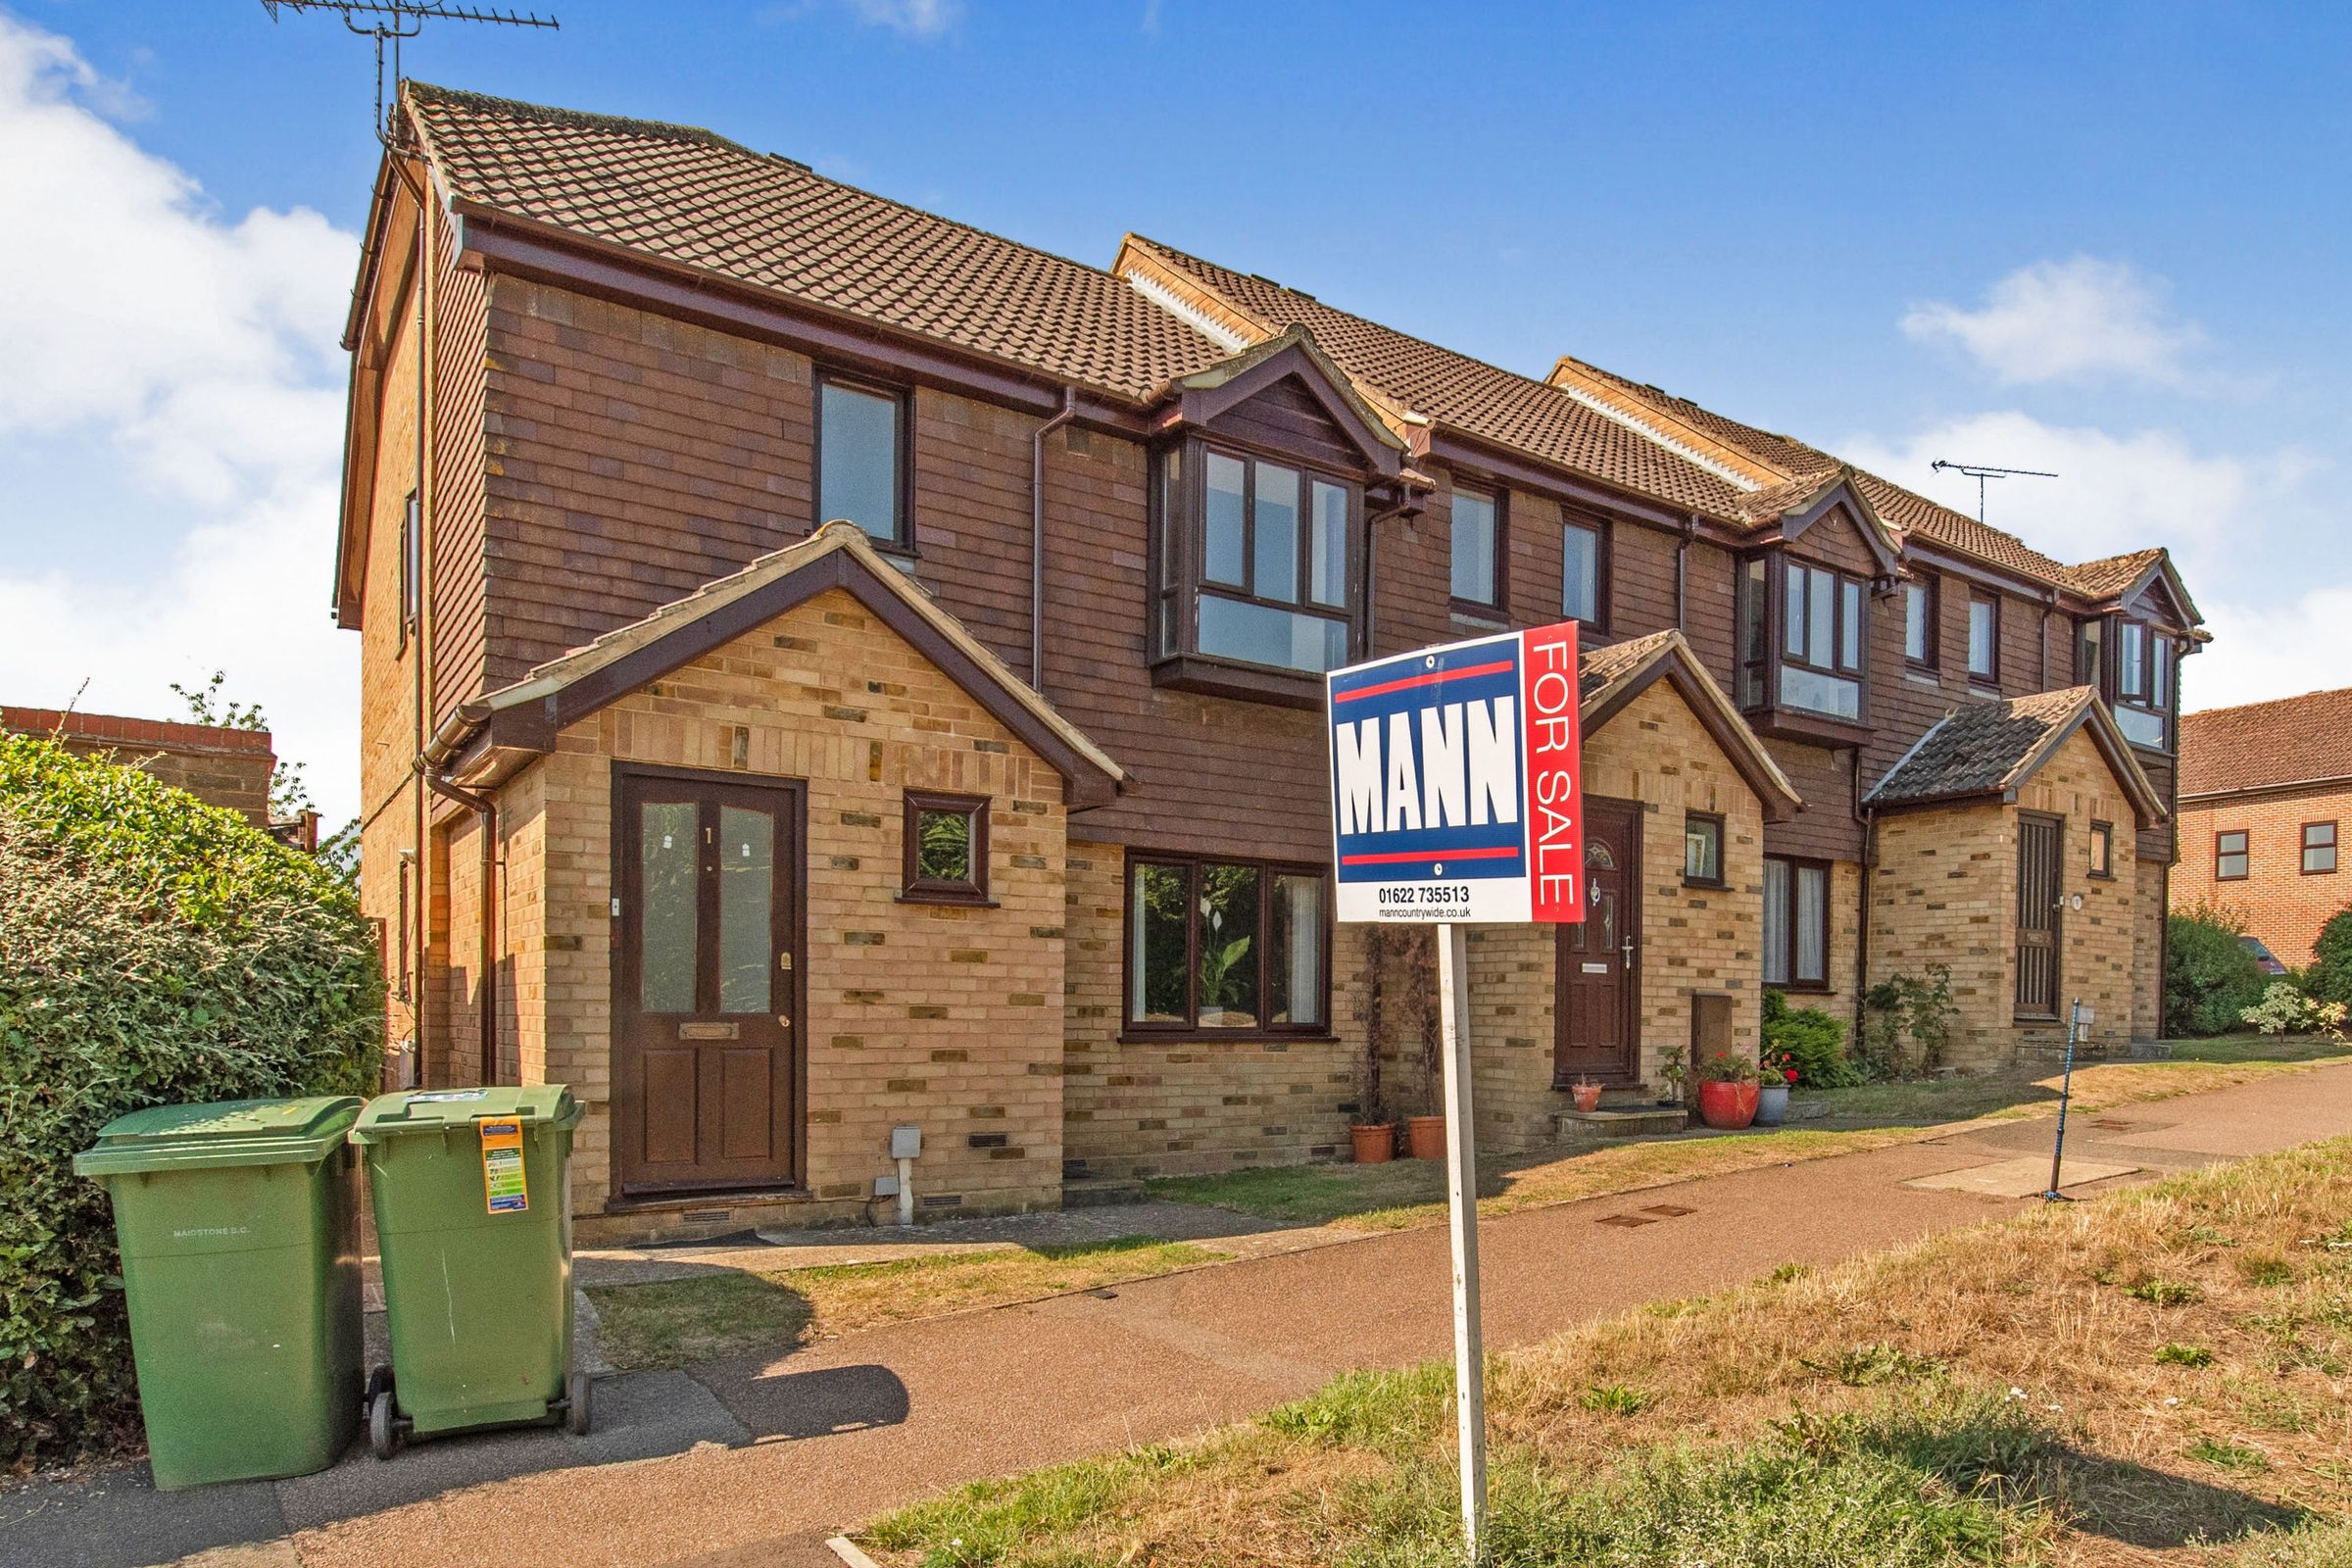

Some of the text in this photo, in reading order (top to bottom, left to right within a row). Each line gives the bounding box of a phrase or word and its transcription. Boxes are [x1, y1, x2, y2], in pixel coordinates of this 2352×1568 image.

[1336, 695, 1518, 835] MANN
[1533, 641, 1574, 905] FOR SALE
[705, 827, 712, 844] 1
[1379, 886, 1470, 904] 01622 735513
[1379, 906, 1471, 920] manncountrywide.co.uk
[173, 1227, 228, 1237] MAIDSTONE
